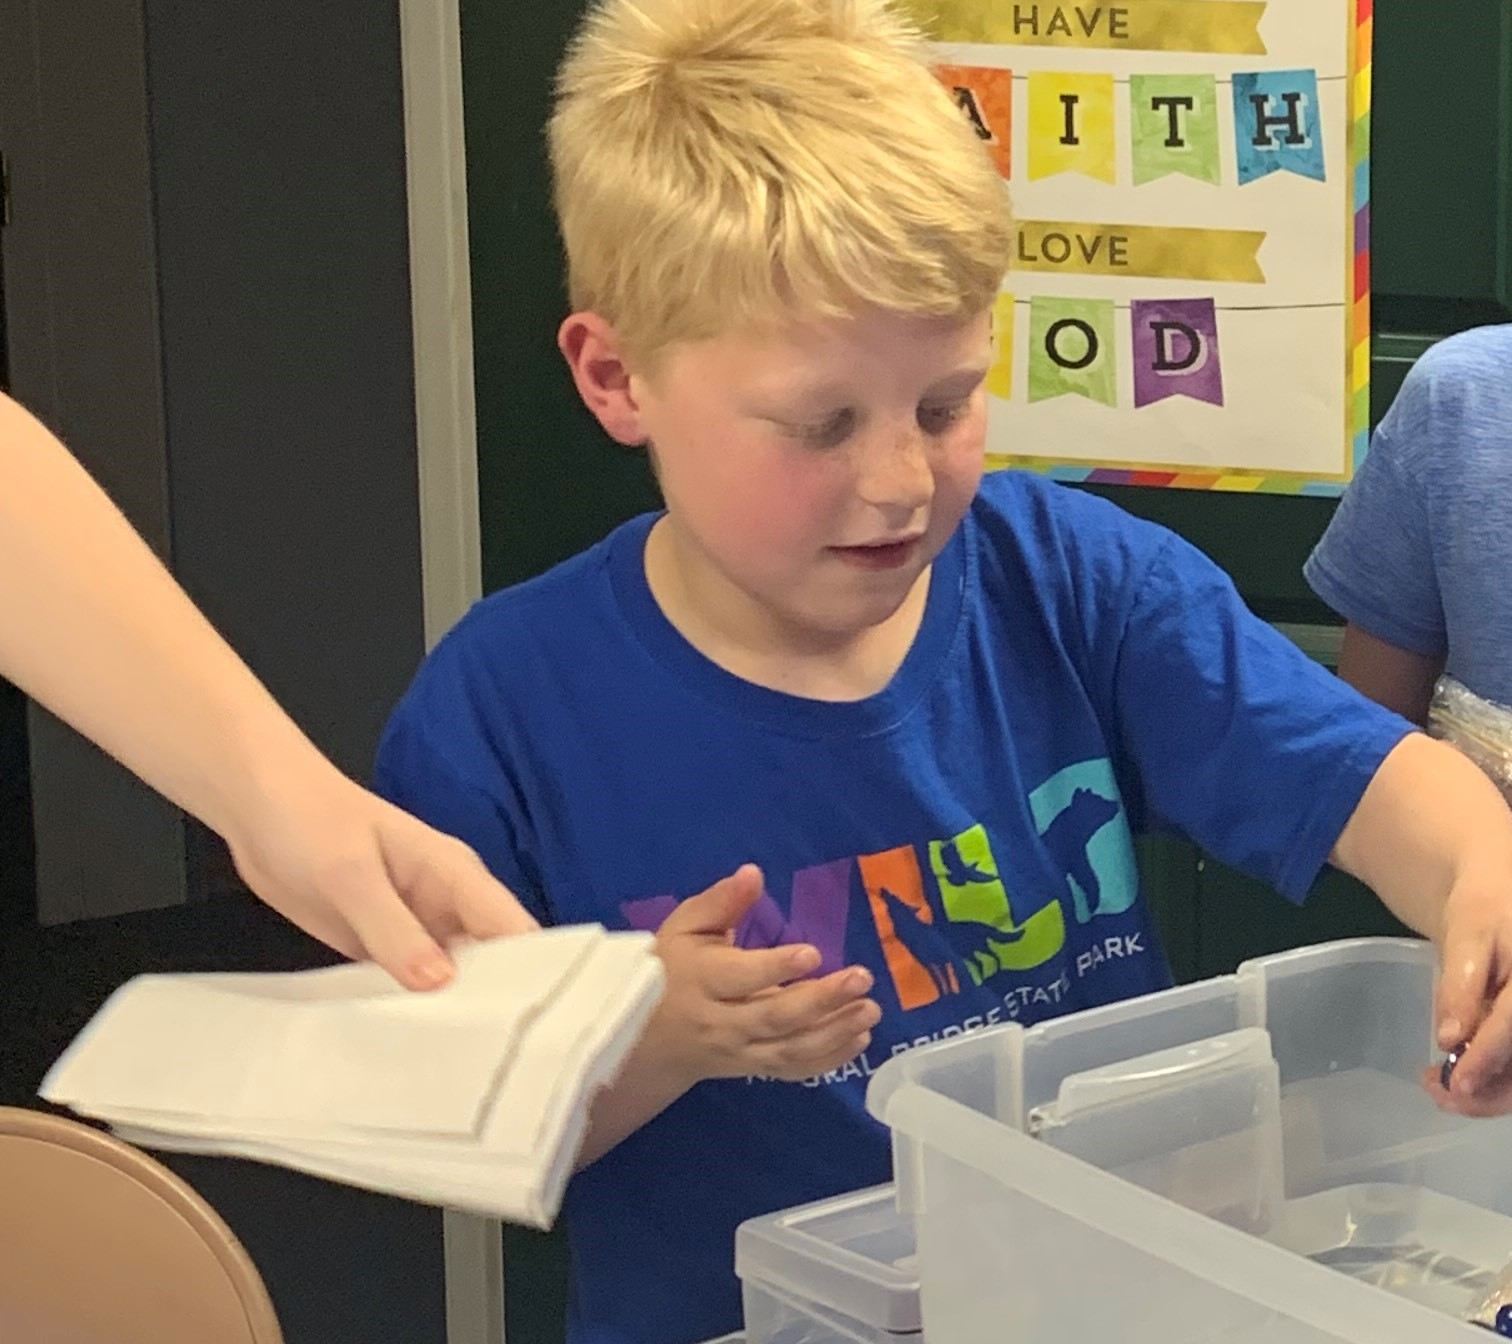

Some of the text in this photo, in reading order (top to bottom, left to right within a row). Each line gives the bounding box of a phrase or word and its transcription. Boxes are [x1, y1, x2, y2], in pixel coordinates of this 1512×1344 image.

[1013, 4, 1129, 39] HAVE
[951, 86, 1310, 150] AITH
[1018, 231, 1129, 267] LOVE
[1040, 318, 1208, 373] OD
[1076, 932, 1145, 977] PARK
